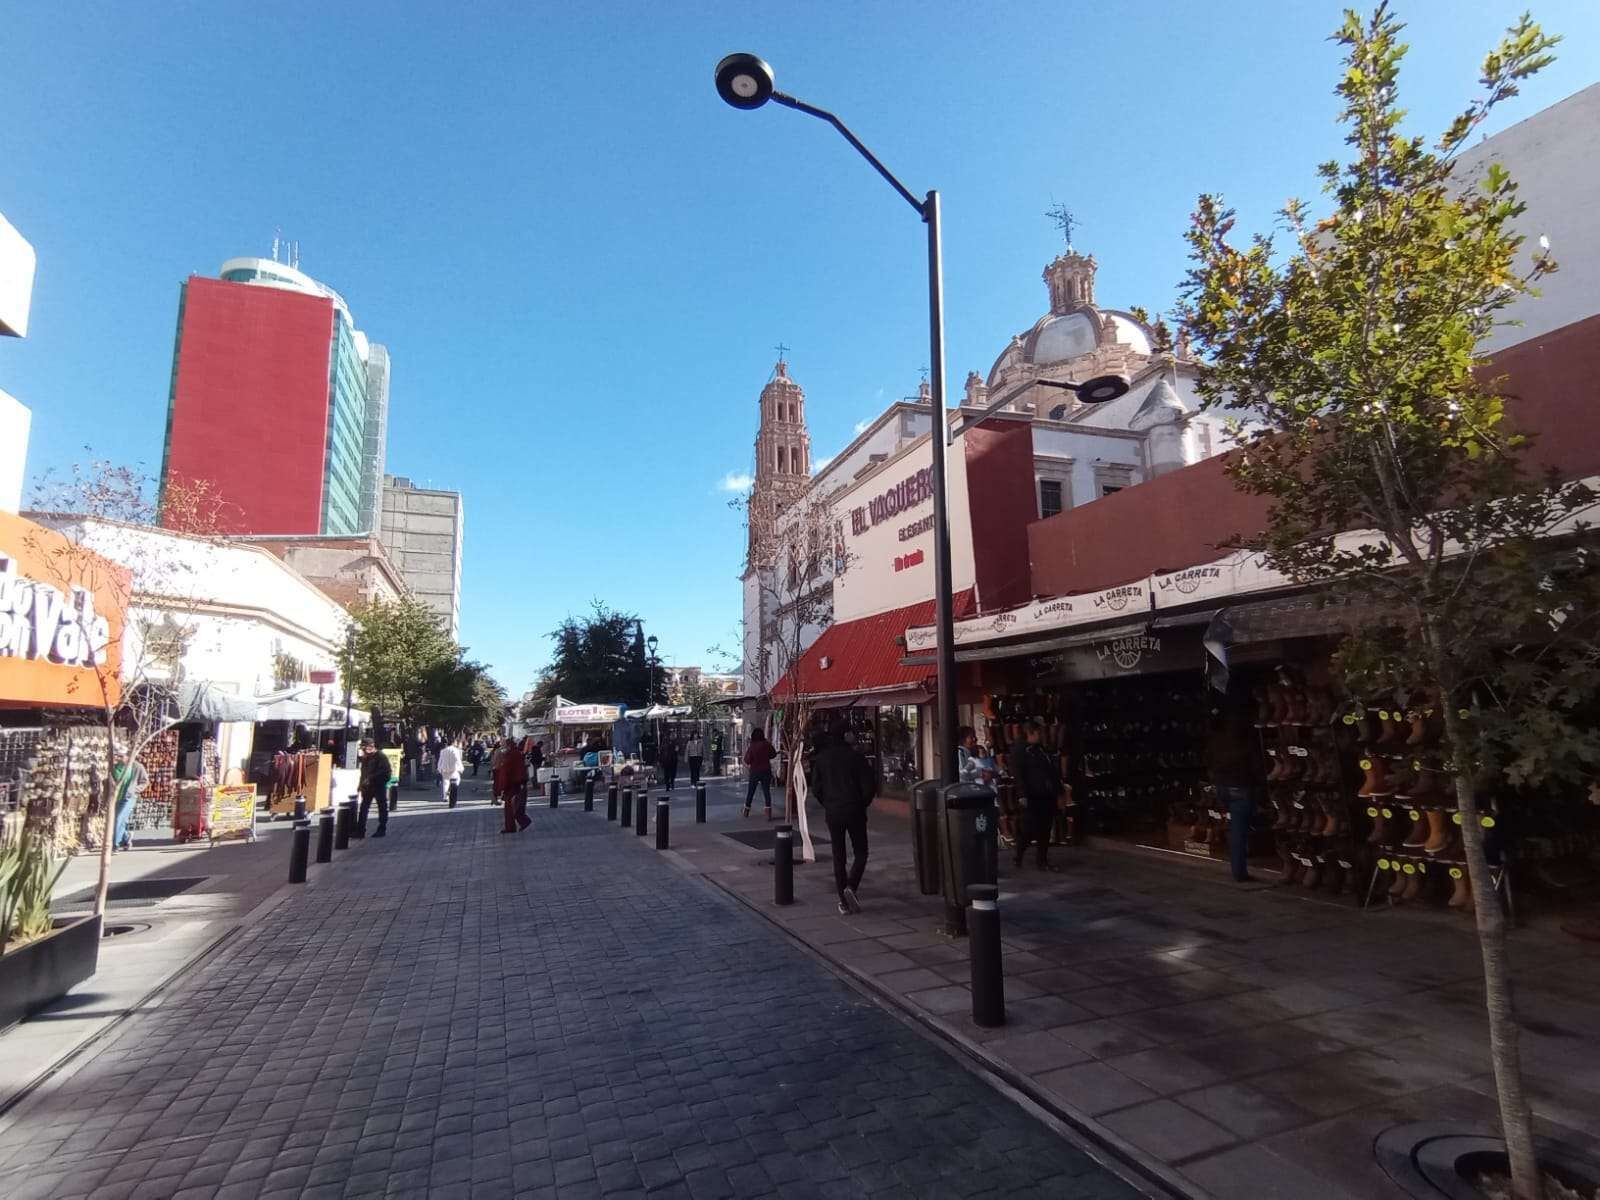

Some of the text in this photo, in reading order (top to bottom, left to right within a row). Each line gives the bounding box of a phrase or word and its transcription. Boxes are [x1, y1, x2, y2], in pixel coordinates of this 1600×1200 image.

[851, 506, 869, 536] EL
[898, 513, 935, 542] ELEGANT
[1158, 566, 1221, 590] LA CARRETA
[1093, 586, 1142, 608] LA CARRETA
[1034, 602, 1073, 620] LA CARRETA
[1096, 636, 1161, 661] LA CARRETA
[558, 708, 592, 717] ELOTES
